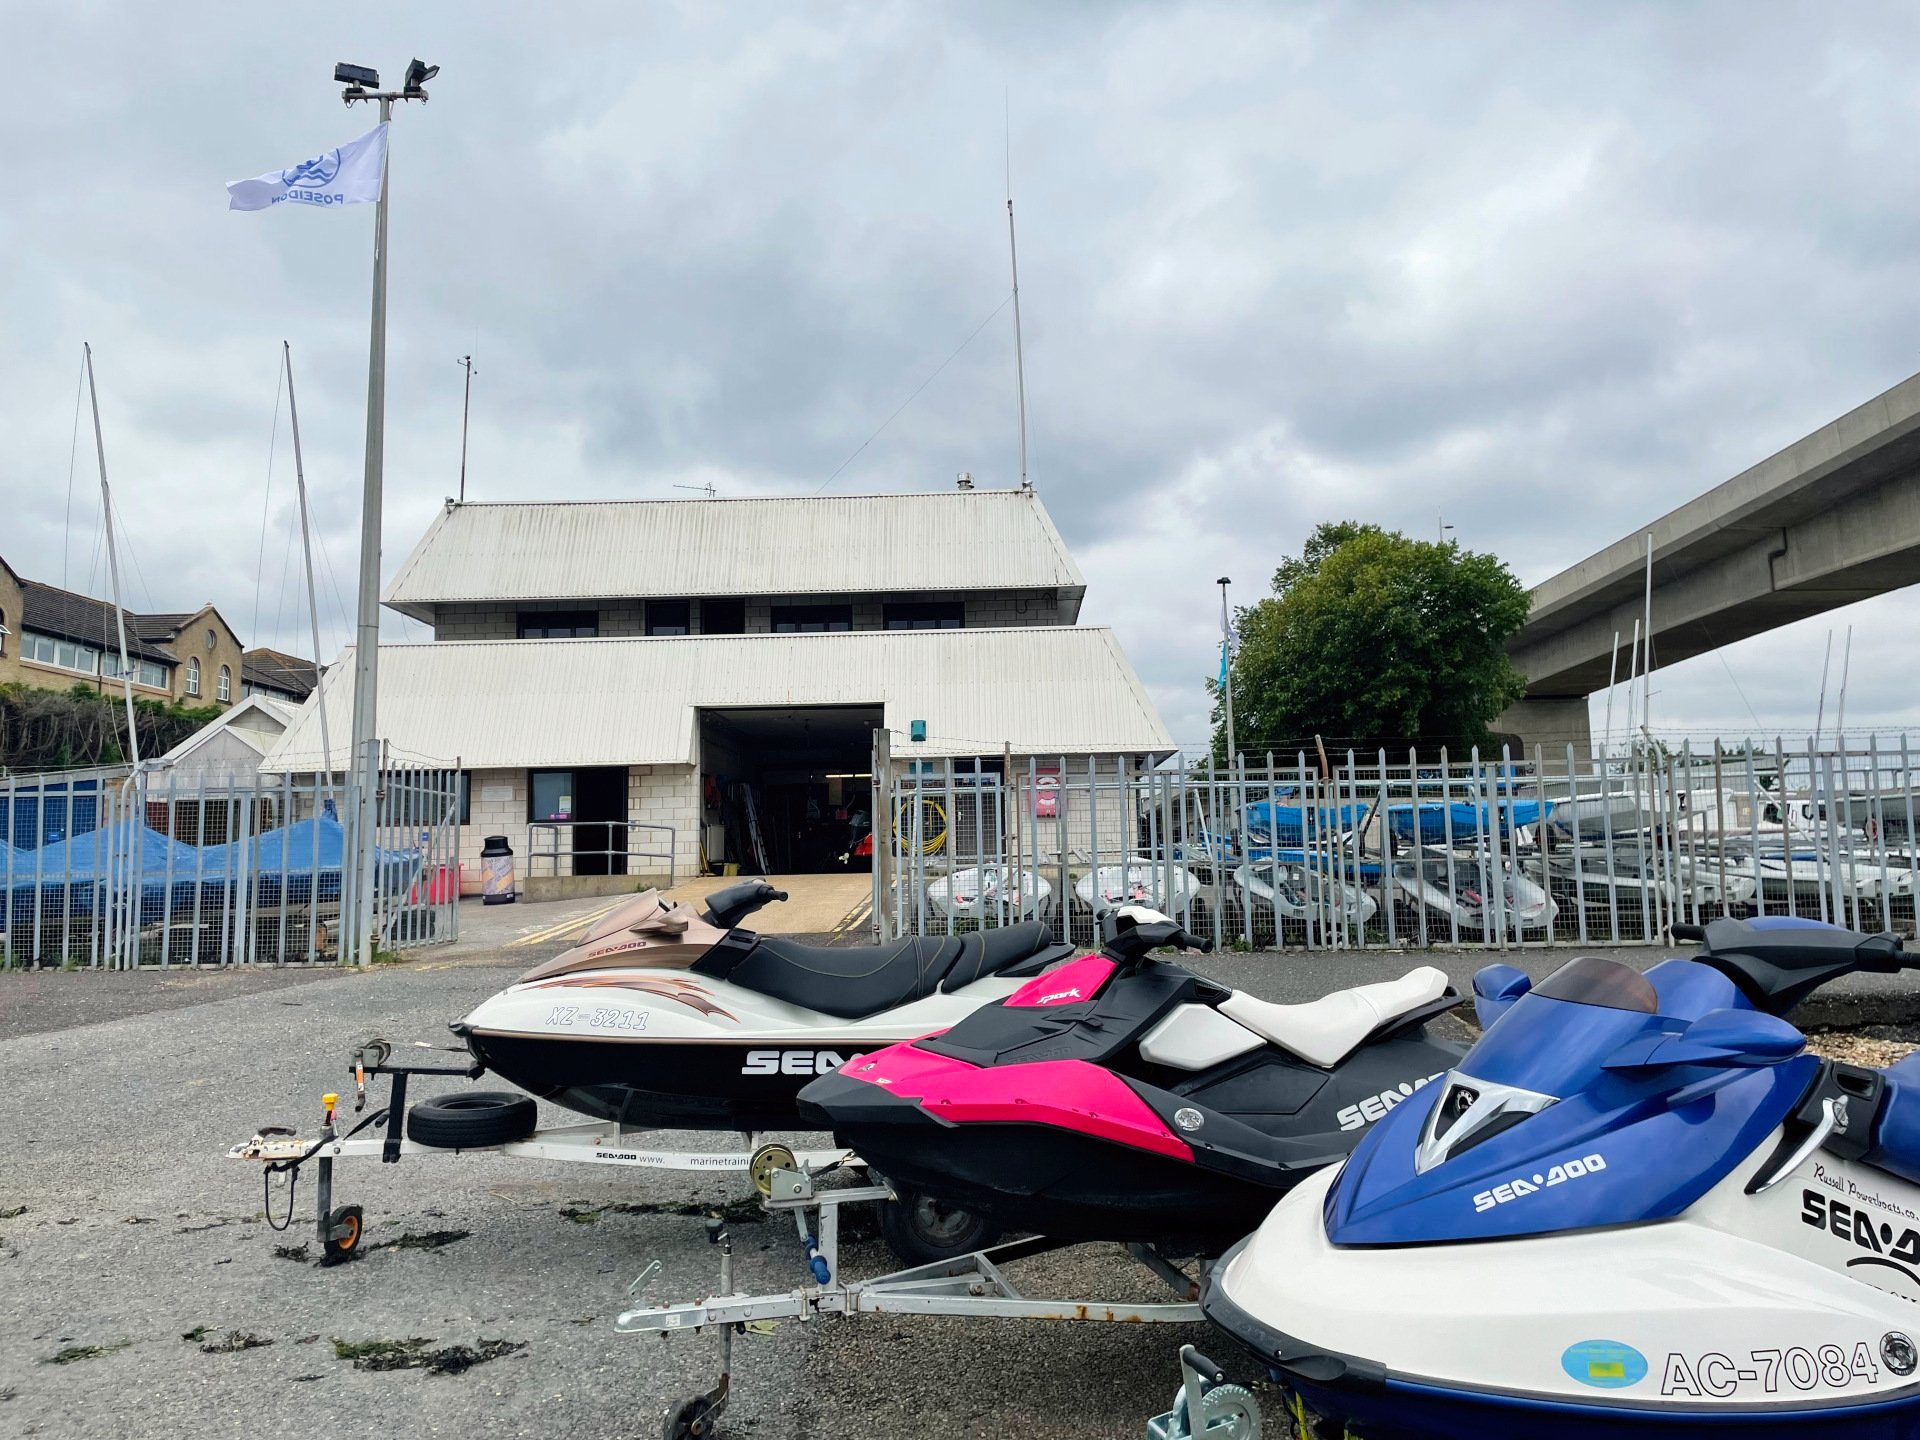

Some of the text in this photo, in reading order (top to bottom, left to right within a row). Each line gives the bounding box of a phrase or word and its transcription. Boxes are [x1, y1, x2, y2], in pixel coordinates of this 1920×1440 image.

[1036, 988, 1080, 1004] spark
[545, 1006, 650, 1031] XZ-3211
[1813, 1162, 1845, 1193] Russell
[1660, 1341, 1879, 1398] AC-7084
